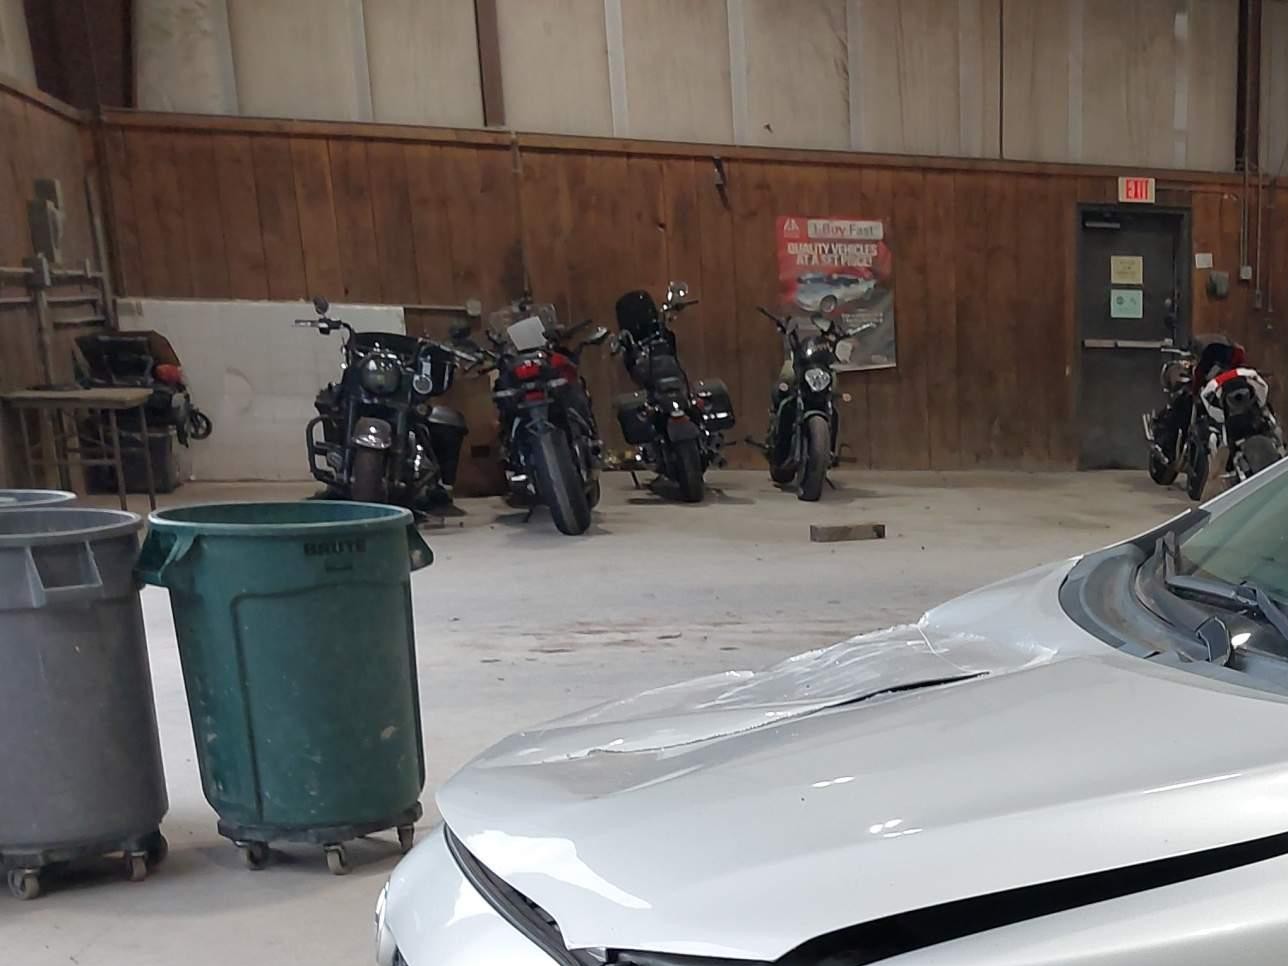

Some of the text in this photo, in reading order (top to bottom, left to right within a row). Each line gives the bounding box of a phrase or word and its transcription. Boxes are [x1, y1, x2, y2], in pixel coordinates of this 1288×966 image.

[1126, 178, 1148, 200] EXIT
[787, 242, 878, 257] QUALITY VEHICLES
